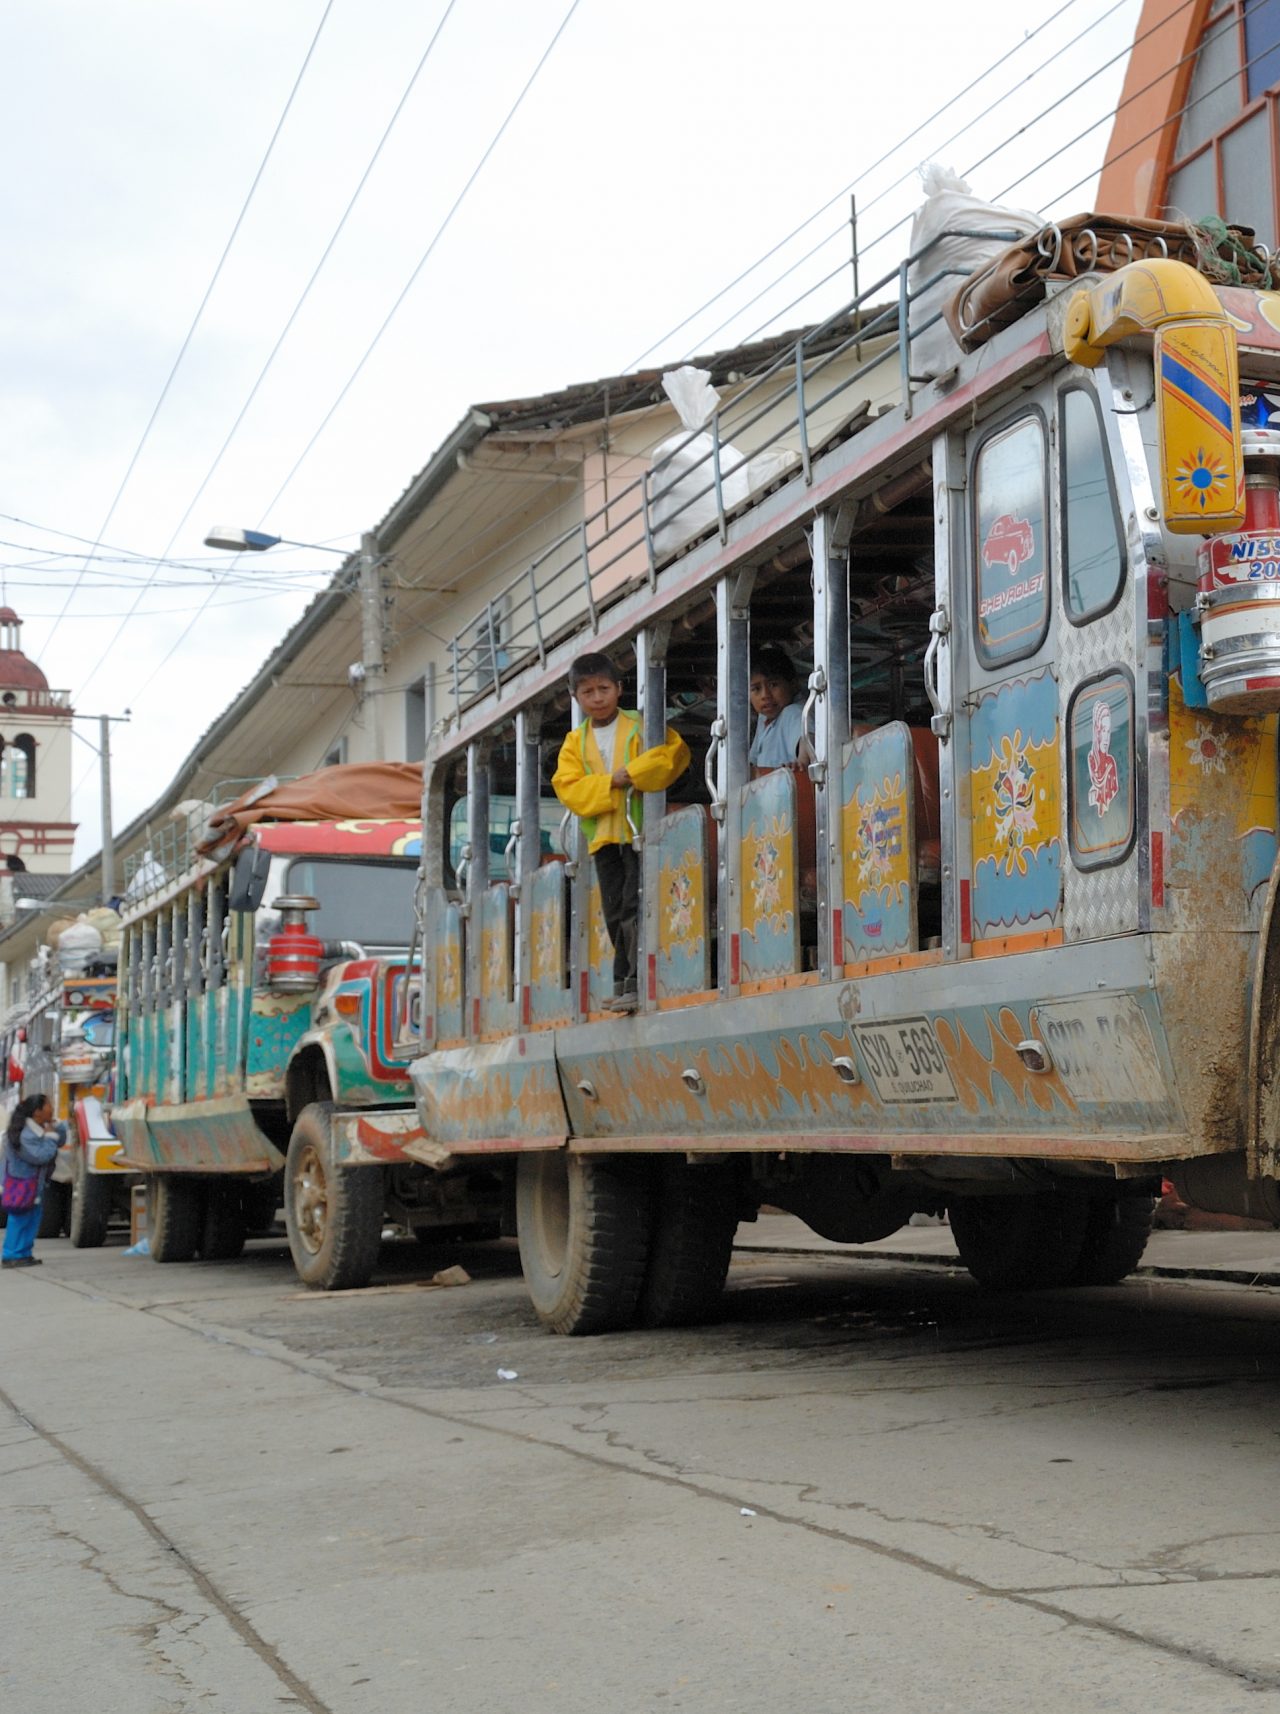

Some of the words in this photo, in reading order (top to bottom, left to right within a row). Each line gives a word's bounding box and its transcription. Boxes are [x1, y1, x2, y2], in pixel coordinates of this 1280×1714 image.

[979, 572, 1045, 618] CHEVROLET
[860, 1033, 900, 1078] SYB
[897, 1026, 944, 1076] 569
